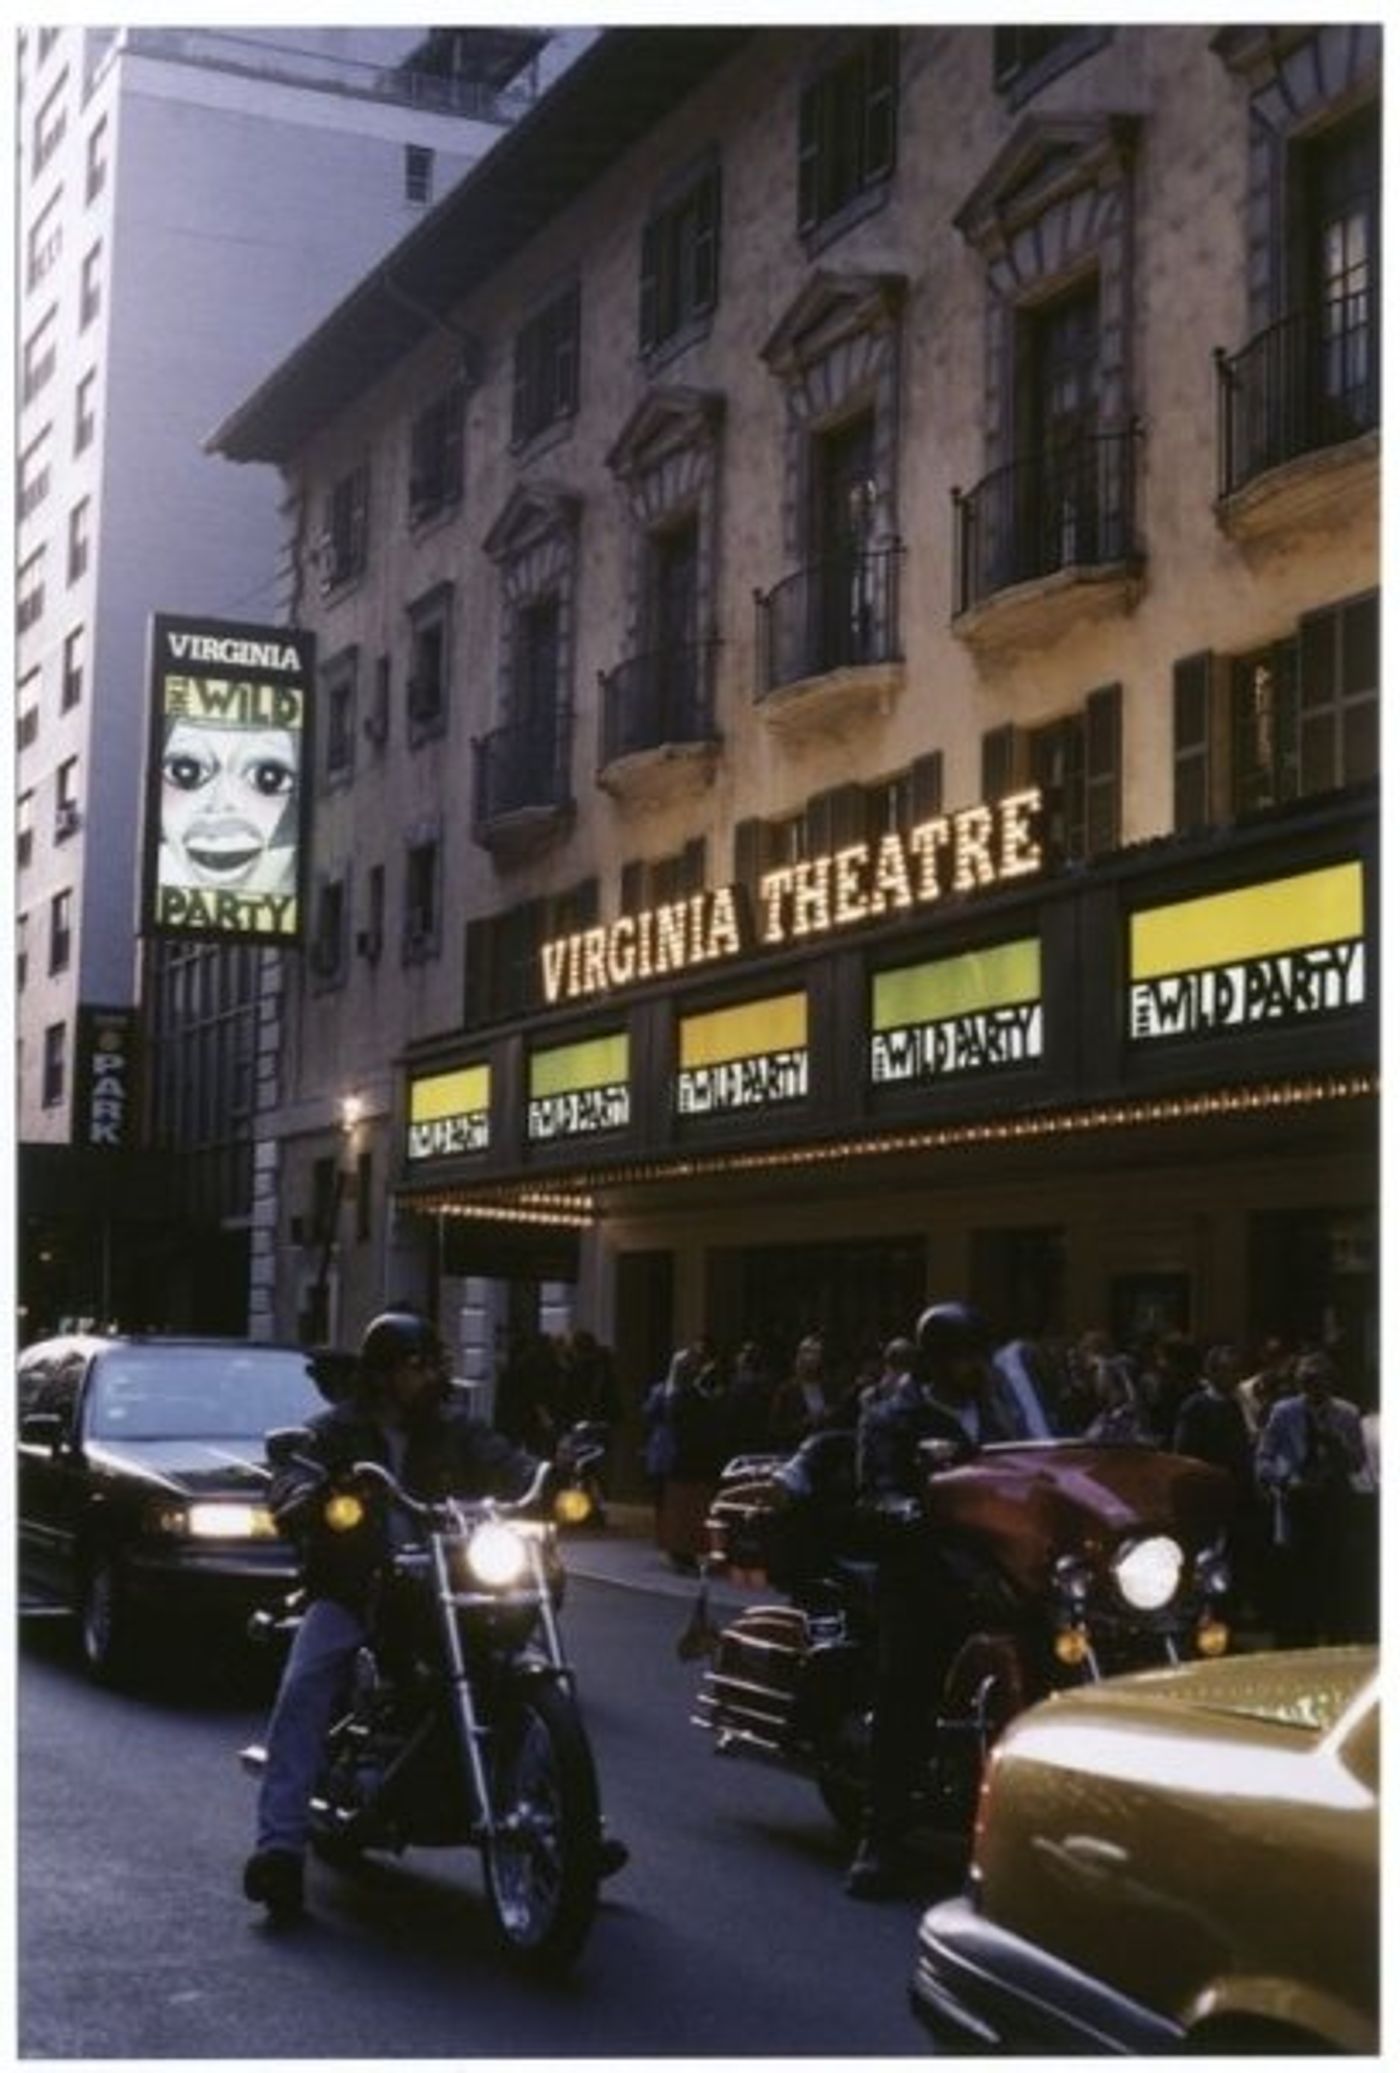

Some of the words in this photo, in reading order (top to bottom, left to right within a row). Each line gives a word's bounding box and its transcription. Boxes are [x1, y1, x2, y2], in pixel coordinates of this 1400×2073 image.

[167, 632, 301, 670] VIRGINIA
[166, 677, 188, 714] THE
[195, 679, 300, 728] WILD
[159, 886, 293, 934] PARTY
[540, 886, 740, 1003] VIRGINIA
[760, 788, 1042, 944] THEATRE
[1149, 968, 1236, 1033] WILD
[1248, 945, 1359, 1020] PARTY
[885, 1022, 949, 1080] WILD
[955, 1006, 1038, 1068] PARTY
[89, 1054, 126, 1144] PARK
[741, 1051, 804, 1104] PARTY
